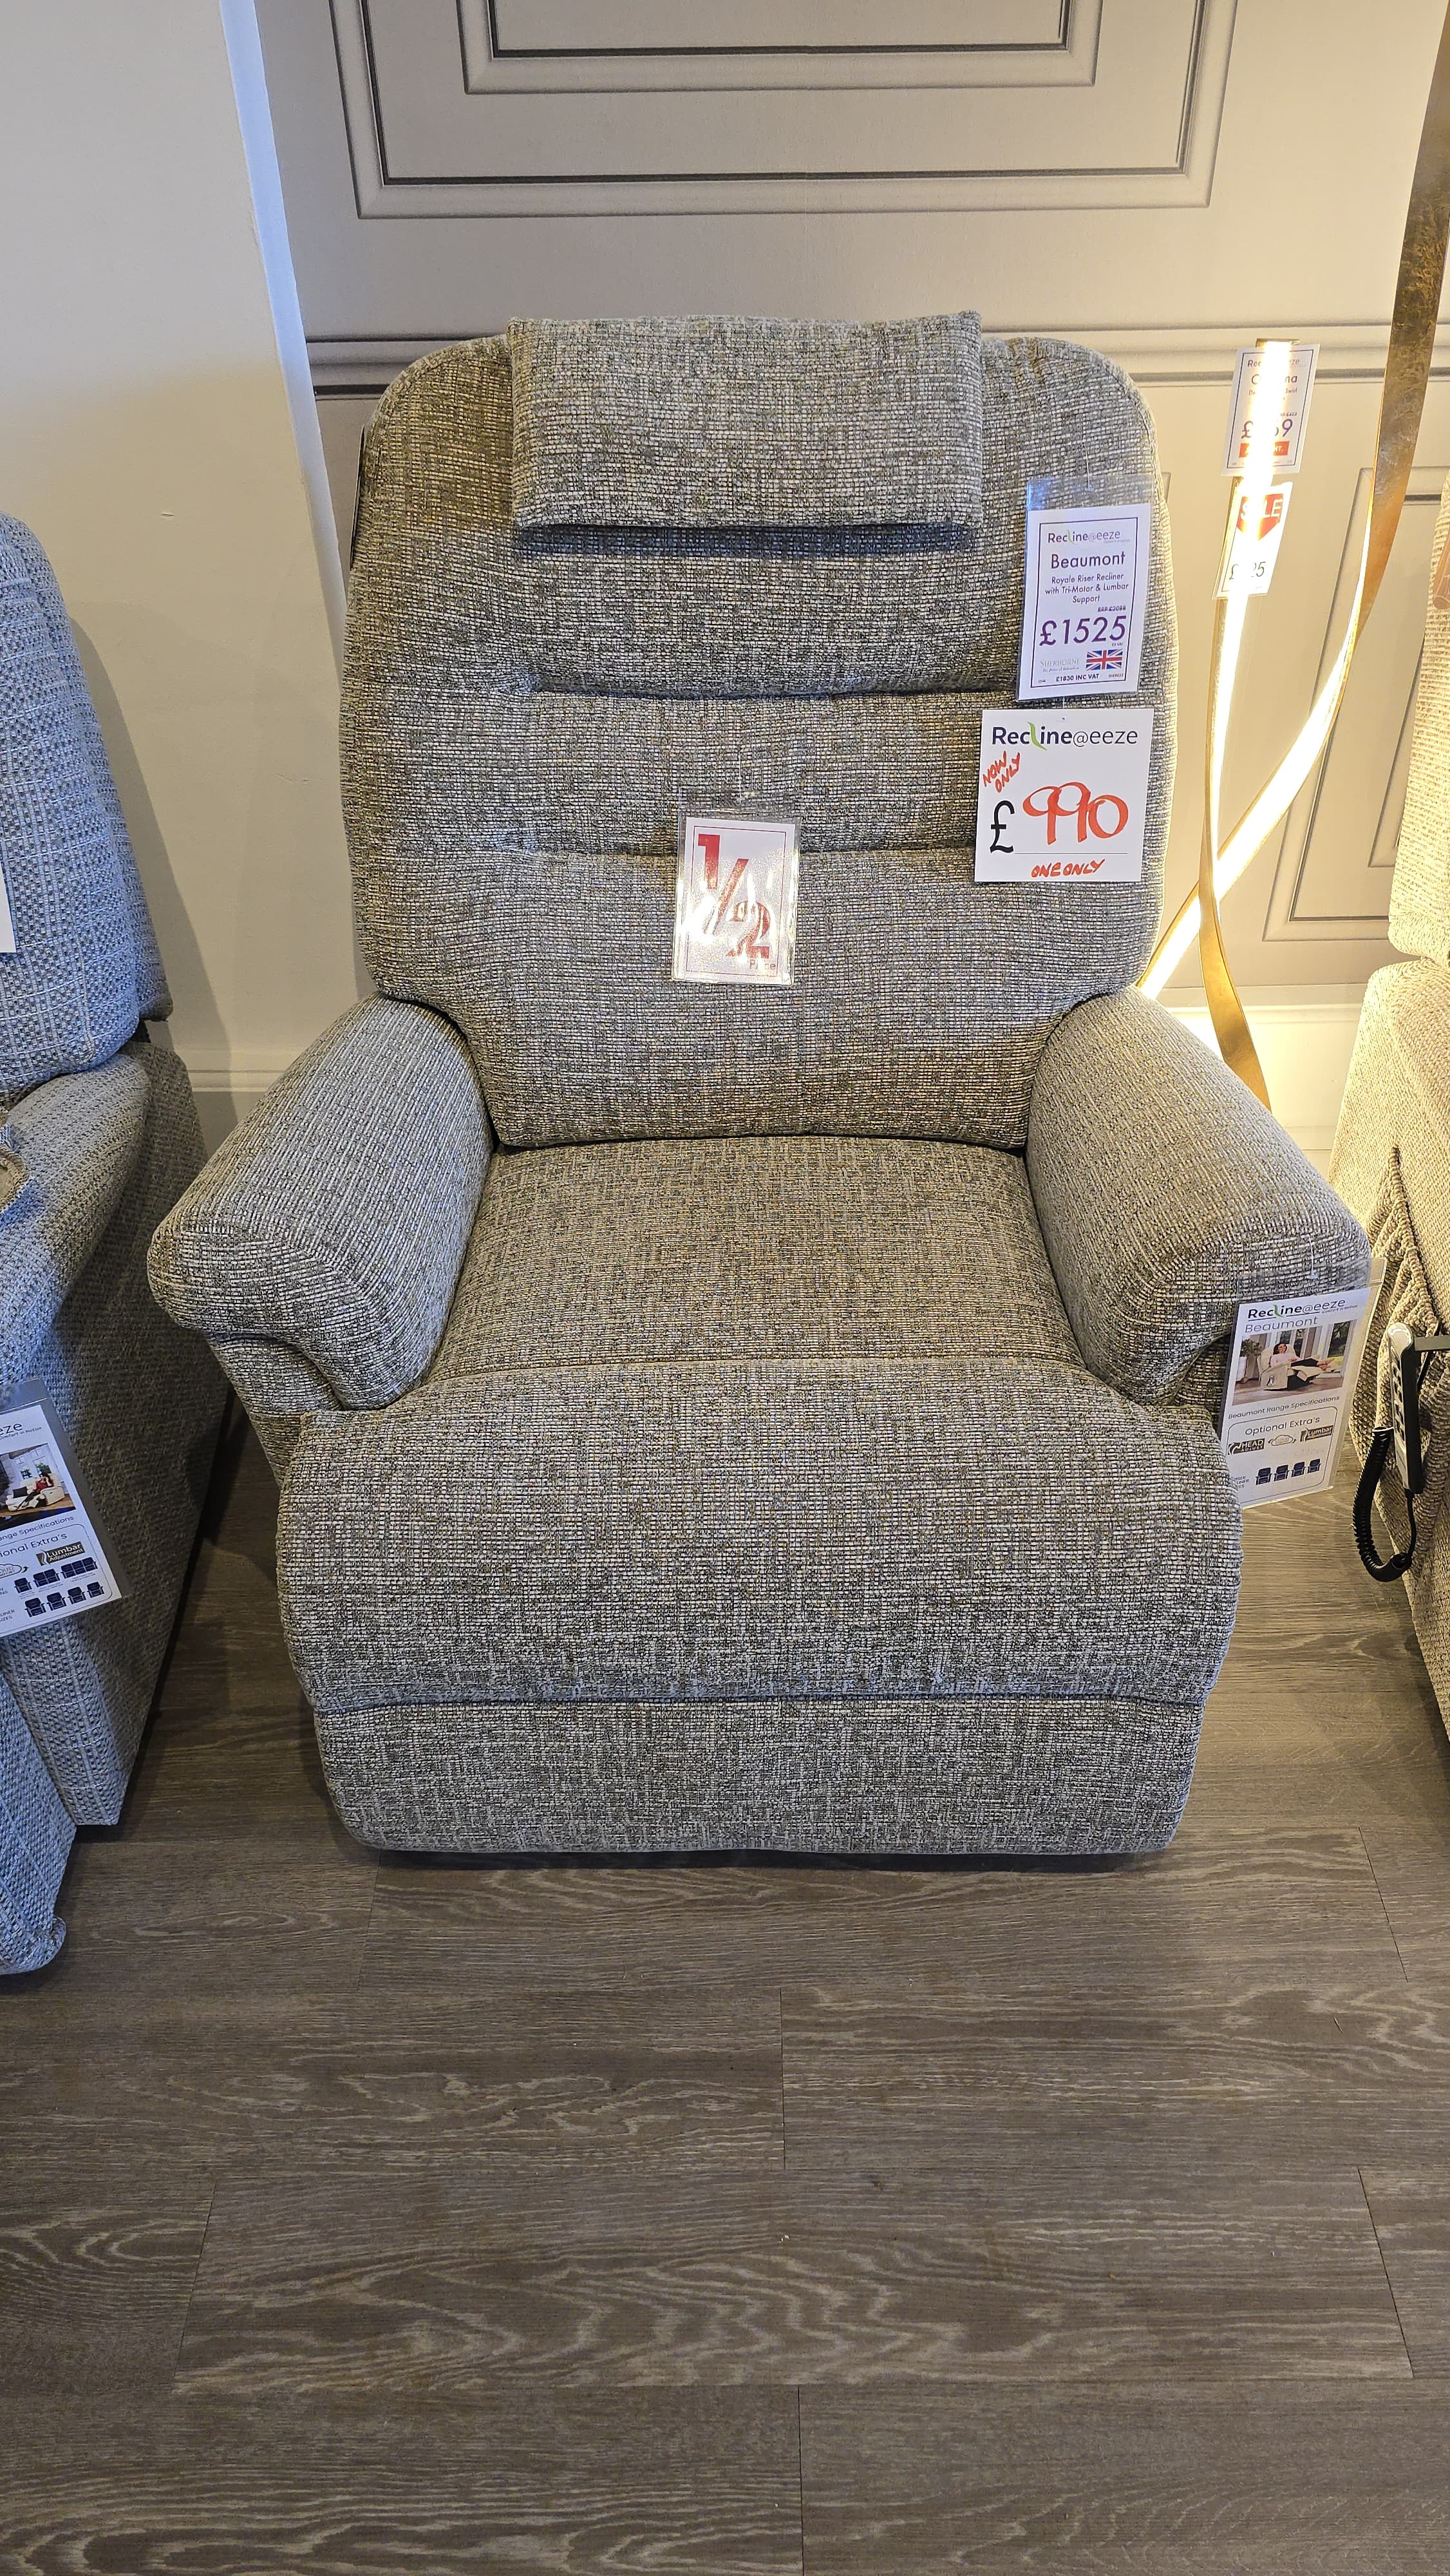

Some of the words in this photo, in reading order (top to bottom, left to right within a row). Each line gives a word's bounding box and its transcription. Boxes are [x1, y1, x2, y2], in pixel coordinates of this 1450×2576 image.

[1051, 551, 1125, 569] Beaumont
[1051, 575, 1075, 586] Royale
[1077, 573, 1095, 583] Riser
[1097, 571, 1124, 582] Recliner
[1045, 587, 1059, 595] with
[1062, 585, 1093, 594] Tri-Motor
[1103, 582, 1129, 592] Lumbar
[1072, 594, 1100, 605] Support
[1039, 614, 1127, 646] £1525
[992, 721, 1138, 750] Recline@eeze
[982, 750, 1008, 788] NOW
[995, 752, 1021, 793] ONLY
[990, 800, 1015, 854] £
[1022, 781, 1129, 846] 990
[1030, 861, 1062, 878] ONE
[1062, 858, 1106, 876] ONLY
[1245, 1316, 1318, 1333] Beaumont
[1228, 1408, 1265, 1419] Beaumont
[1266, 1405, 1289, 1413] Range
[1291, 1395, 1341, 1409] Specifications
[1245, 1421, 1287, 1436] Optional
[1290, 1416, 1321, 1428] Extra's
[1242, 1439, 1263, 1448] HEAD
[0, 1532, 18, 1542] ange
[19, 1515, 75, 1535] Specifications
[31, 1533, 68, 1548] Extra's
[47, 1543, 80, 1558] Lumbar
[48, 1548, 84, 1562] Adjustment
